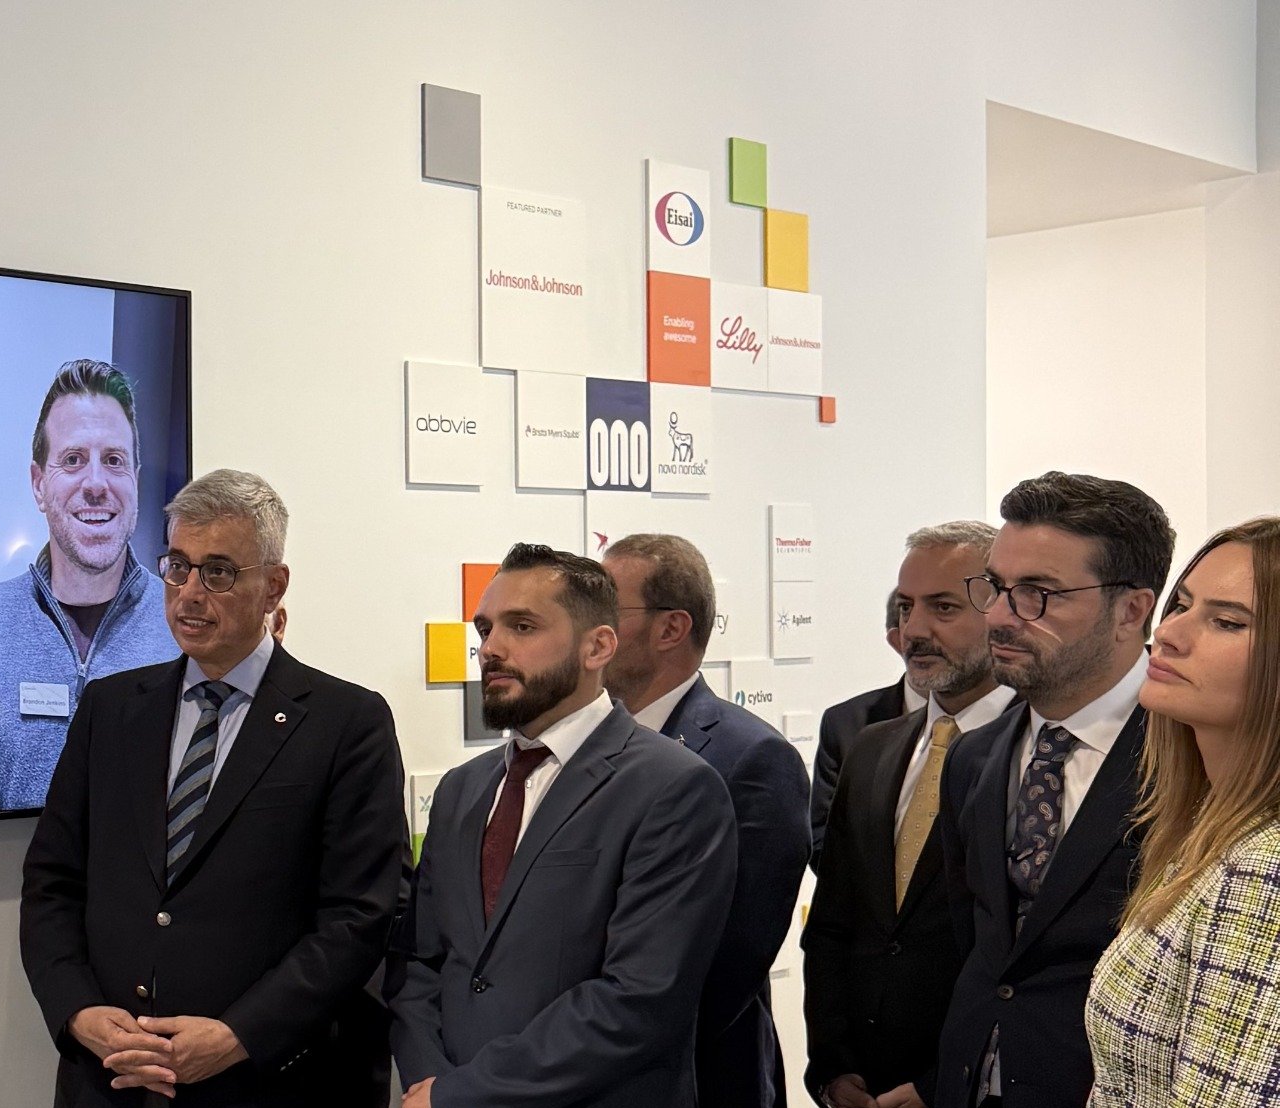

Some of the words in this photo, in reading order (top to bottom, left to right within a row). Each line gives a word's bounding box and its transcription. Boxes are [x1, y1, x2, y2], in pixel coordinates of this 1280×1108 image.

[506, 201, 536, 213] FEATURED
[537, 205, 563, 217] PARTNER
[666, 208, 694, 229] Eisai
[485, 269, 583, 296] Johnson&Johnson
[663, 315, 695, 331] Enabling
[663, 334, 697, 344] awesome
[716, 316, 763, 365] Lilly
[416, 414, 478, 435] abbvie
[658, 463, 677, 474] novo
[678, 461, 706, 475] nordisk
[792, 615, 812, 627] Agilent
[747, 690, 773, 705] cytiva
